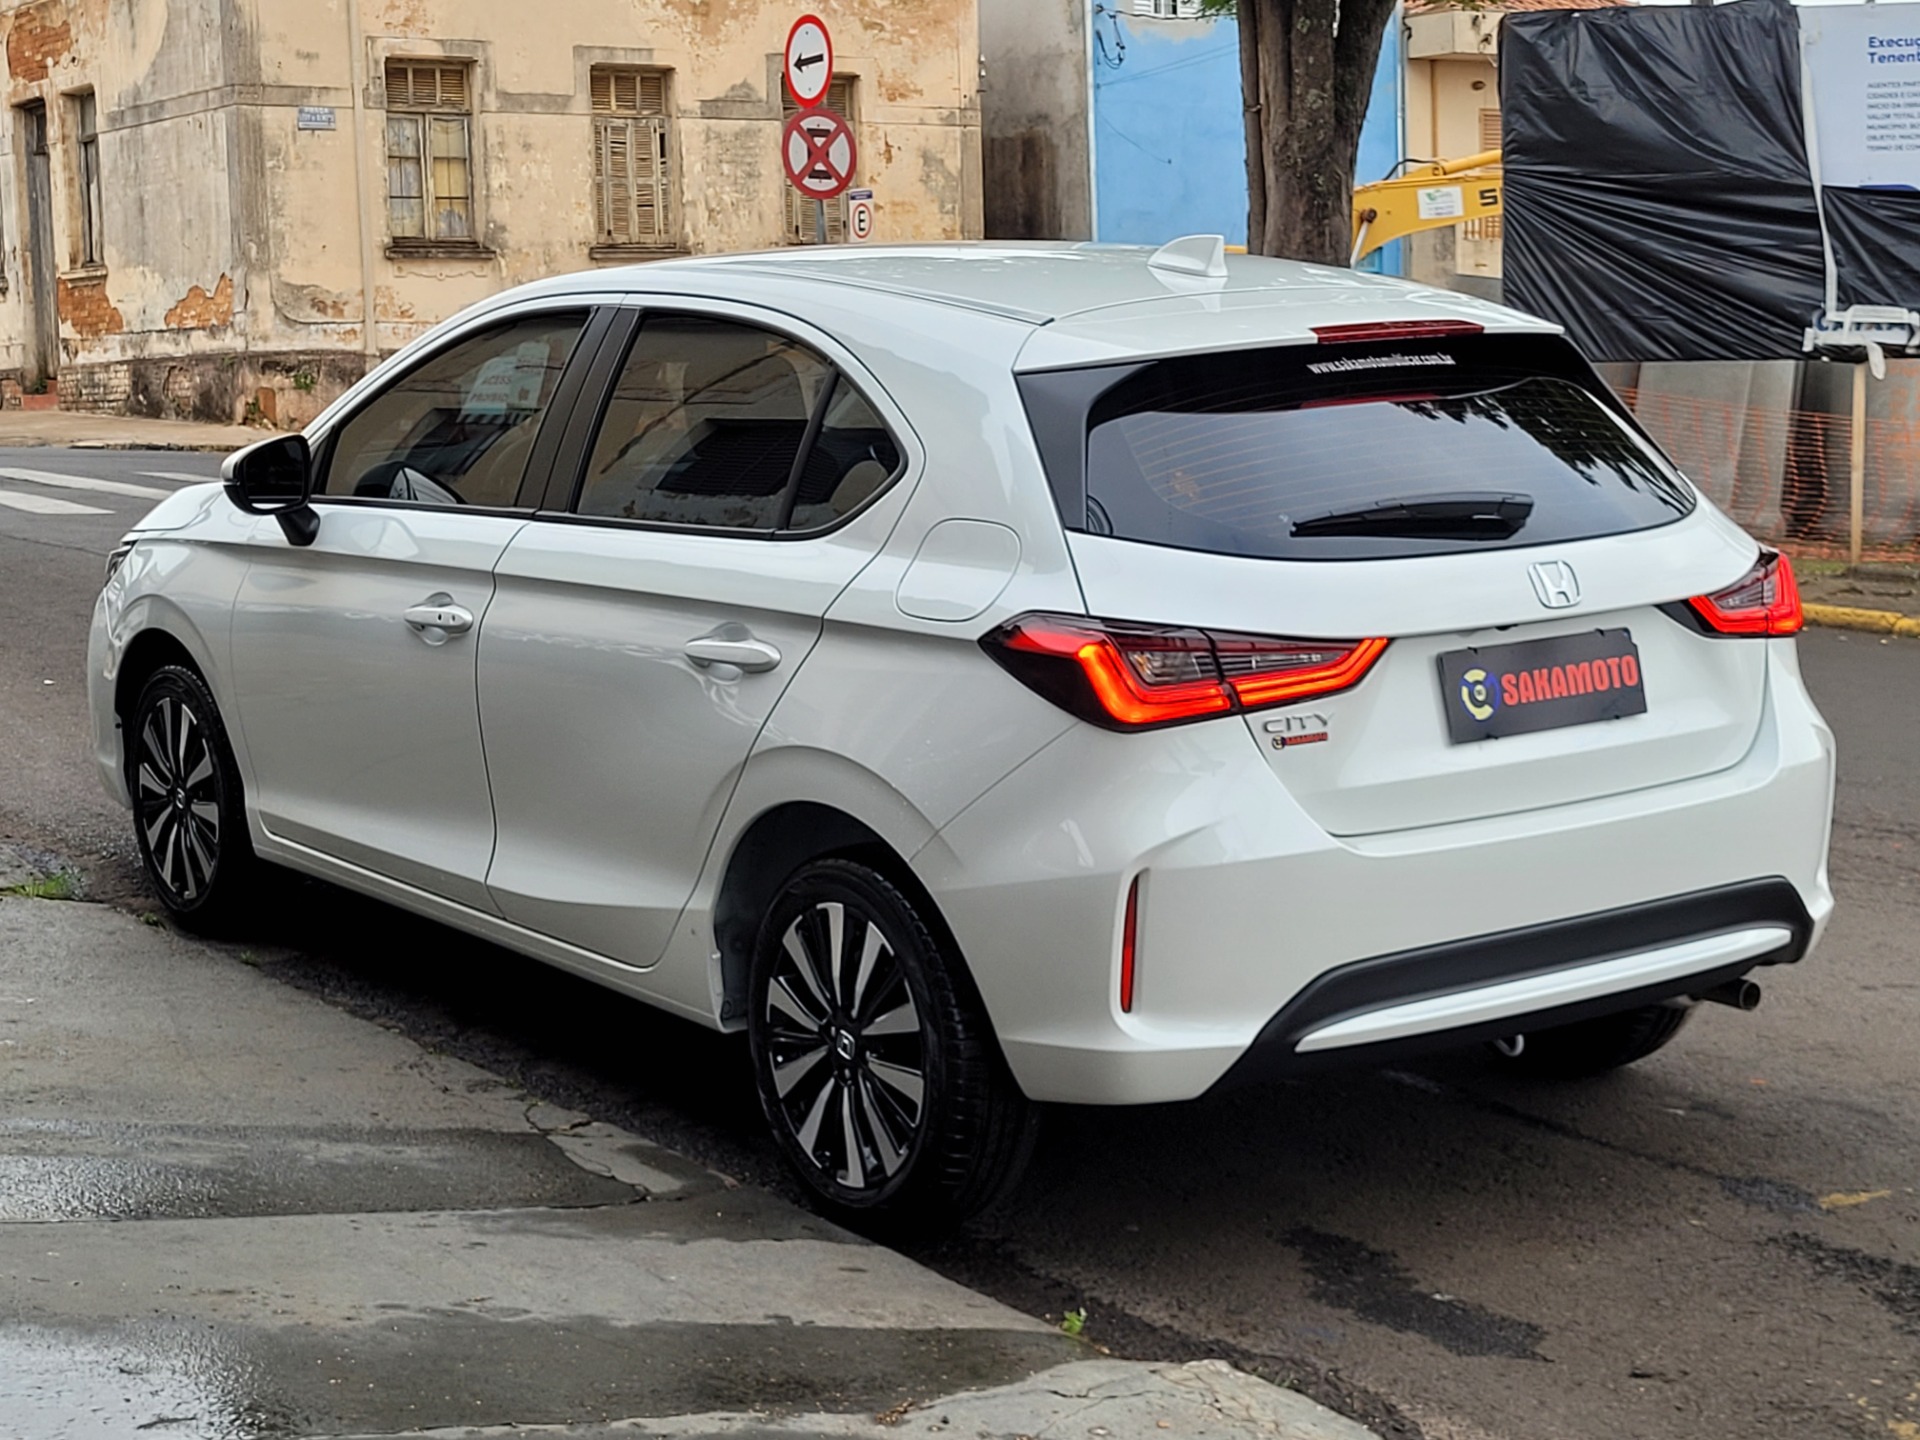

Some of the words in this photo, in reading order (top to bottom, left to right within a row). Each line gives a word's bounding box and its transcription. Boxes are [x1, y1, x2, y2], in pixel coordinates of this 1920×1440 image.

[858, 210, 866, 232] E
[1501, 655, 1639, 706] SAKAMOTO
[1263, 713, 1333, 733] CITY
